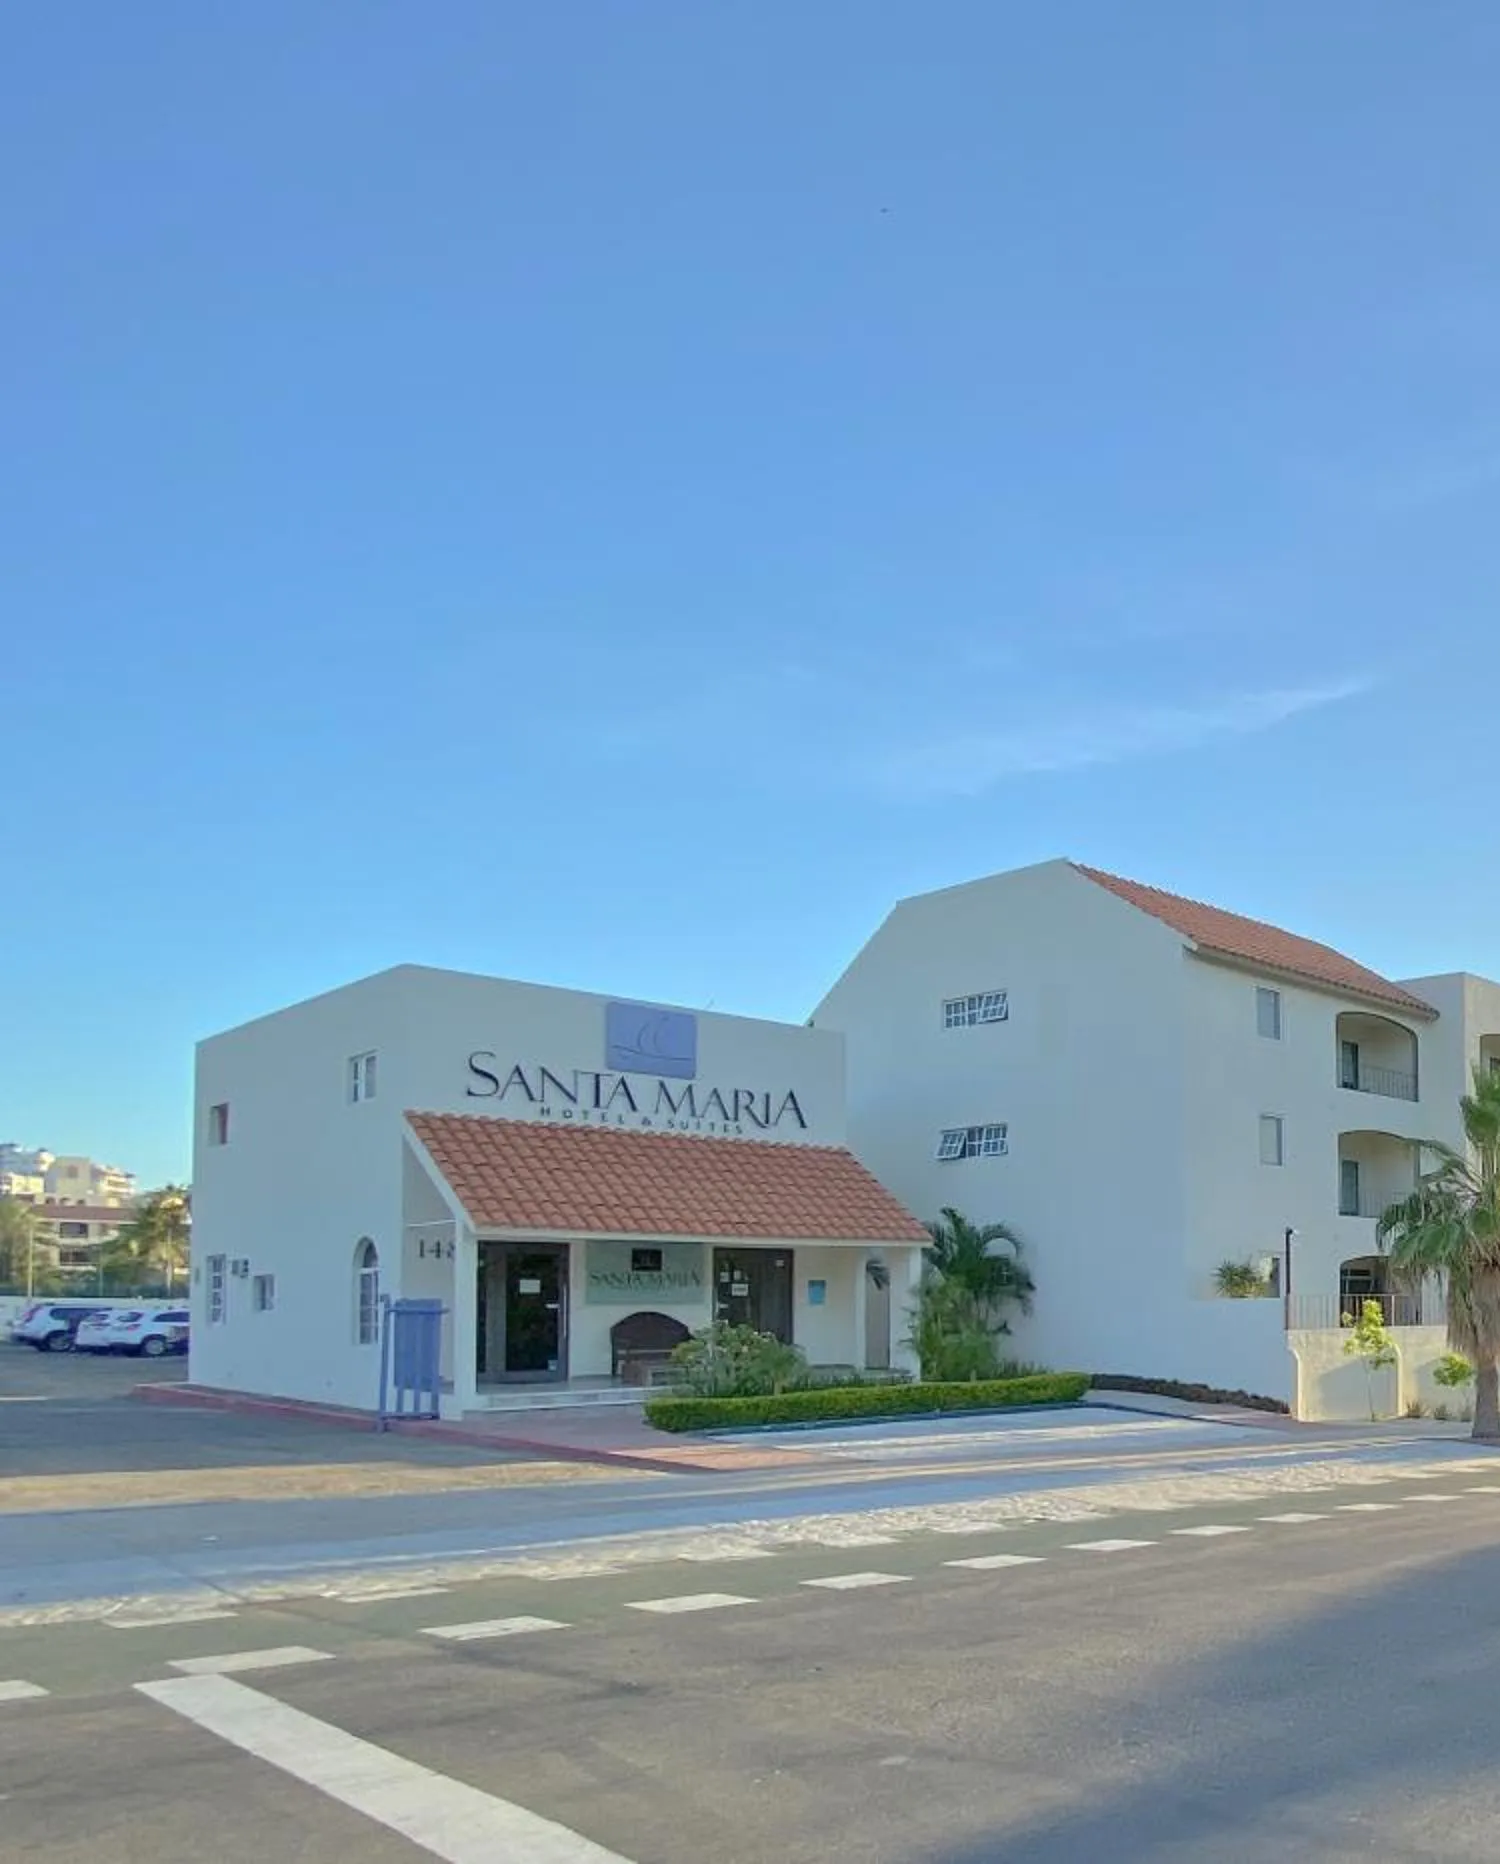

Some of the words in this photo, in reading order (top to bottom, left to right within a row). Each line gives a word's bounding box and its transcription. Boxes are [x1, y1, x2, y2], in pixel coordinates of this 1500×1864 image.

[466, 1051, 638, 1112] SANTA
[654, 1080, 808, 1129] MARIA
[541, 1105, 625, 1125] HOTEL
[667, 1118, 742, 1134] SUITES
